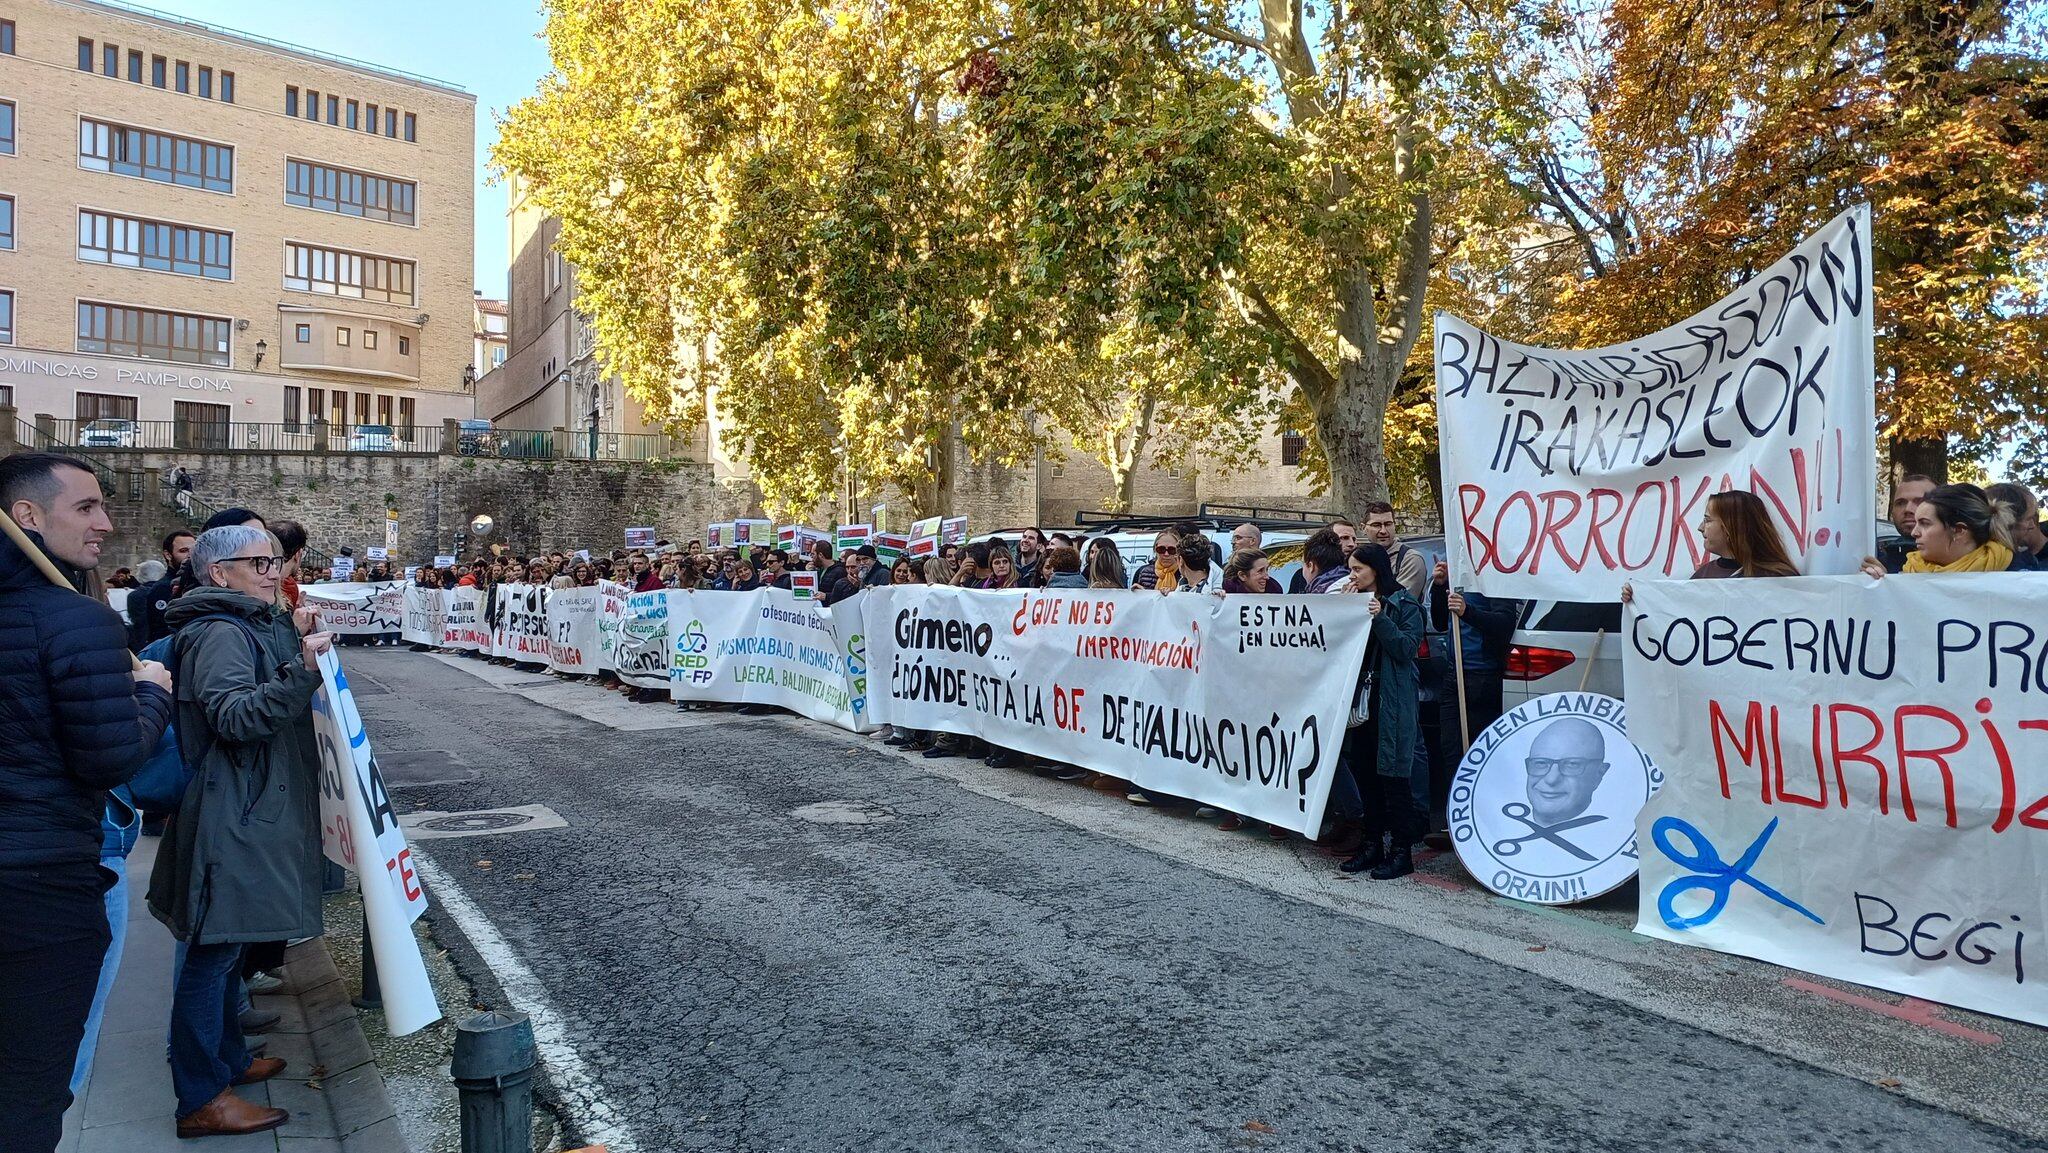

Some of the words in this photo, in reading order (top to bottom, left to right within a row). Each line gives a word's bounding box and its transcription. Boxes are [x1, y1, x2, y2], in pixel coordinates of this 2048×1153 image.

[117, 369, 233, 392] PAMPLONA
[1012, 592, 1063, 636] ¿QUE
[1068, 600, 1088, 625] NO
[1094, 601, 1114, 625] ES
[1239, 630, 1263, 653] ¡EN
[1270, 624, 1327, 652] LUCHA!
[1631, 613, 1896, 681] GOBERNU
[1937, 618, 2048, 694] PR
[674, 654, 708, 669] RED
[800, 645, 833, 671] MISMAS
[891, 654, 968, 707] ¿DÓNDE
[973, 669, 1017, 721] ESTÁ
[1024, 684, 1045, 726] LA
[1053, 682, 1086, 733] O.F.
[1102, 693, 1129, 745] DE
[1132, 699, 1320, 812] EVALUACIÓN?
[1452, 706, 1529, 842] ORONOZEN
[1491, 870, 1588, 901] ORAIN!!
